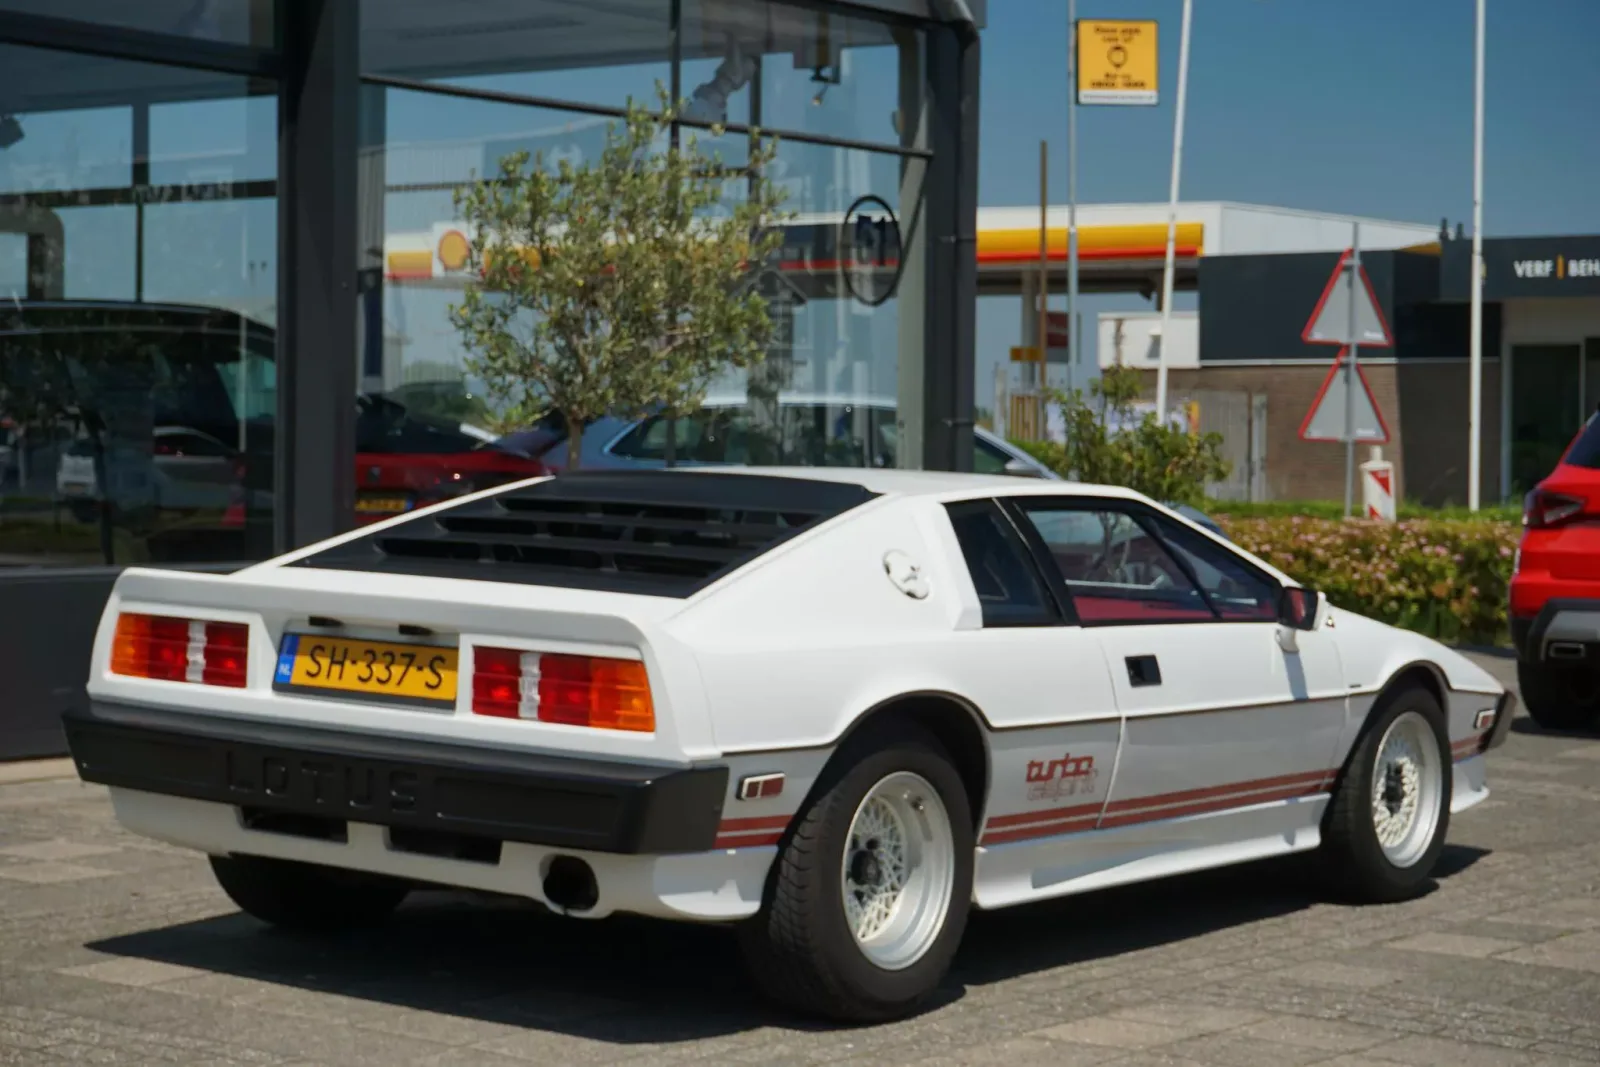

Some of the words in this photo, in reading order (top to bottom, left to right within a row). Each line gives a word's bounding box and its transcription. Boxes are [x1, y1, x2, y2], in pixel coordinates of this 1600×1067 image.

[1513, 259, 1553, 278] VERF
[306, 644, 446, 690] SH-337-S
[226, 751, 419, 814] LOTUS
[1026, 752, 1094, 782] turbo
